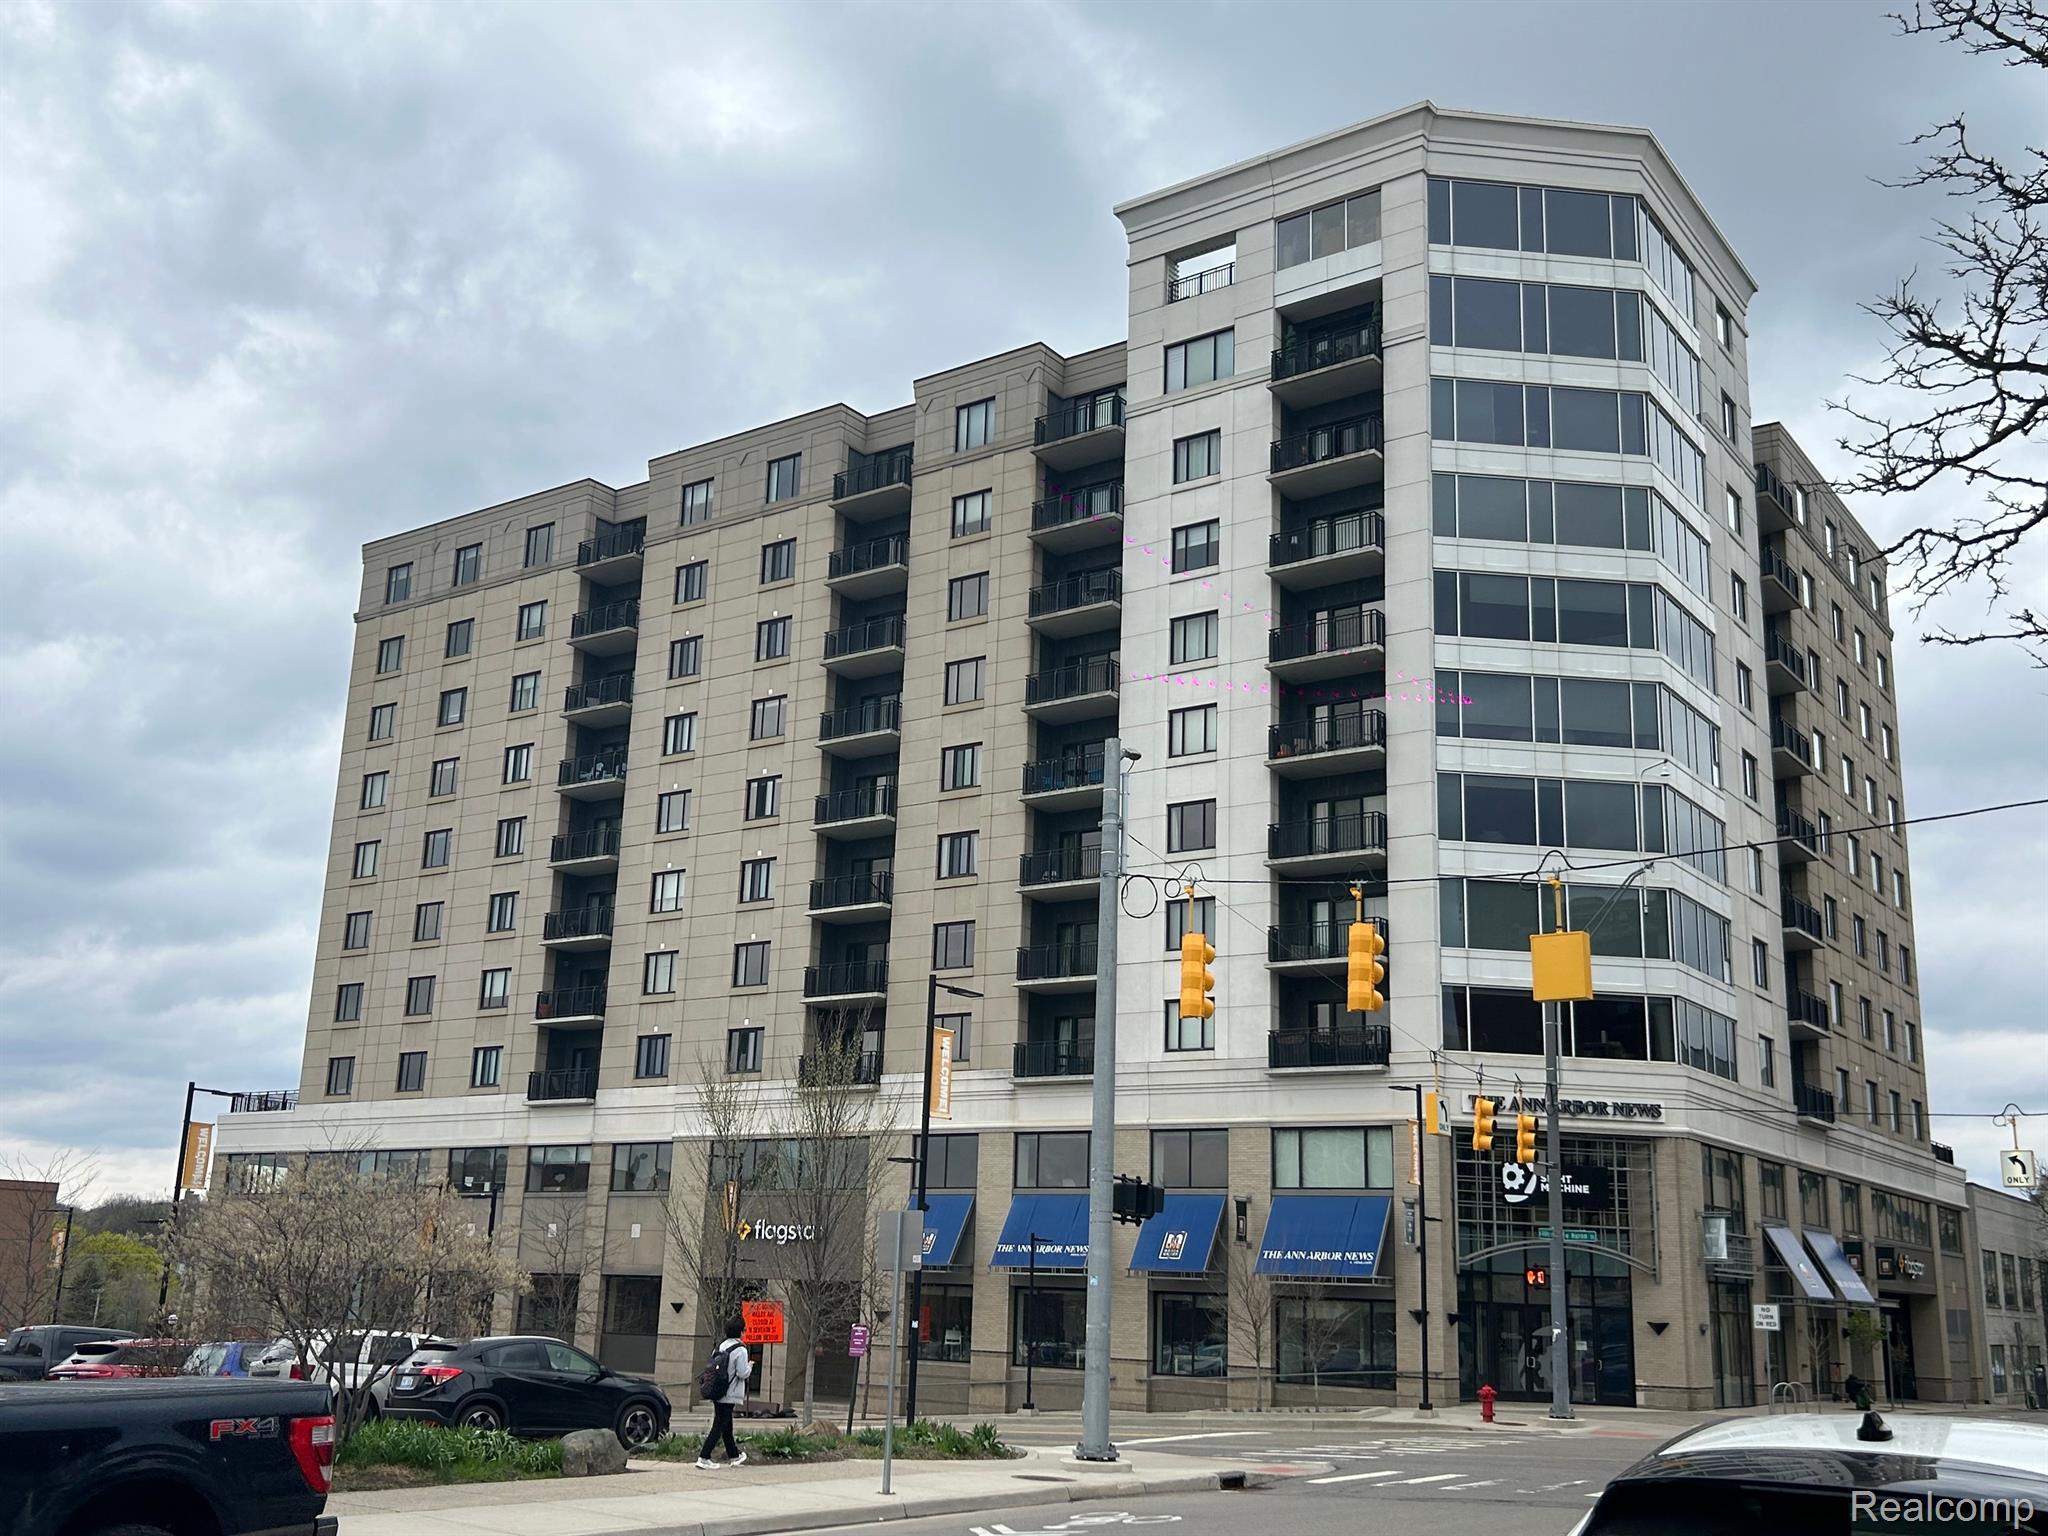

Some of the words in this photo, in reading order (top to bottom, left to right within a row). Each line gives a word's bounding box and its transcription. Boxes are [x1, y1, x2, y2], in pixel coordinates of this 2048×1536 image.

[939, 1036, 951, 1113] WELCOME!
[1556, 1099, 1610, 1117] RBOR
[1612, 1102, 1662, 1119] NEWS
[1540, 1173, 1573, 1184] SIHT
[2006, 1176, 2030, 1184] ONLY
[1540, 1182, 1590, 1194] MHINE
[754, 1218, 823, 1245] flagsta
[997, 1244, 1014, 1253] THE
[1064, 1245, 1089, 1254] NEWS
[1263, 1250, 1283, 1260] THE
[1284, 1250, 1306, 1260] ANN
[1307, 1251, 1342, 1262] ARBOR
[1344, 1251, 1375, 1261] NEWS
[209, 1417, 280, 1441] FX4
